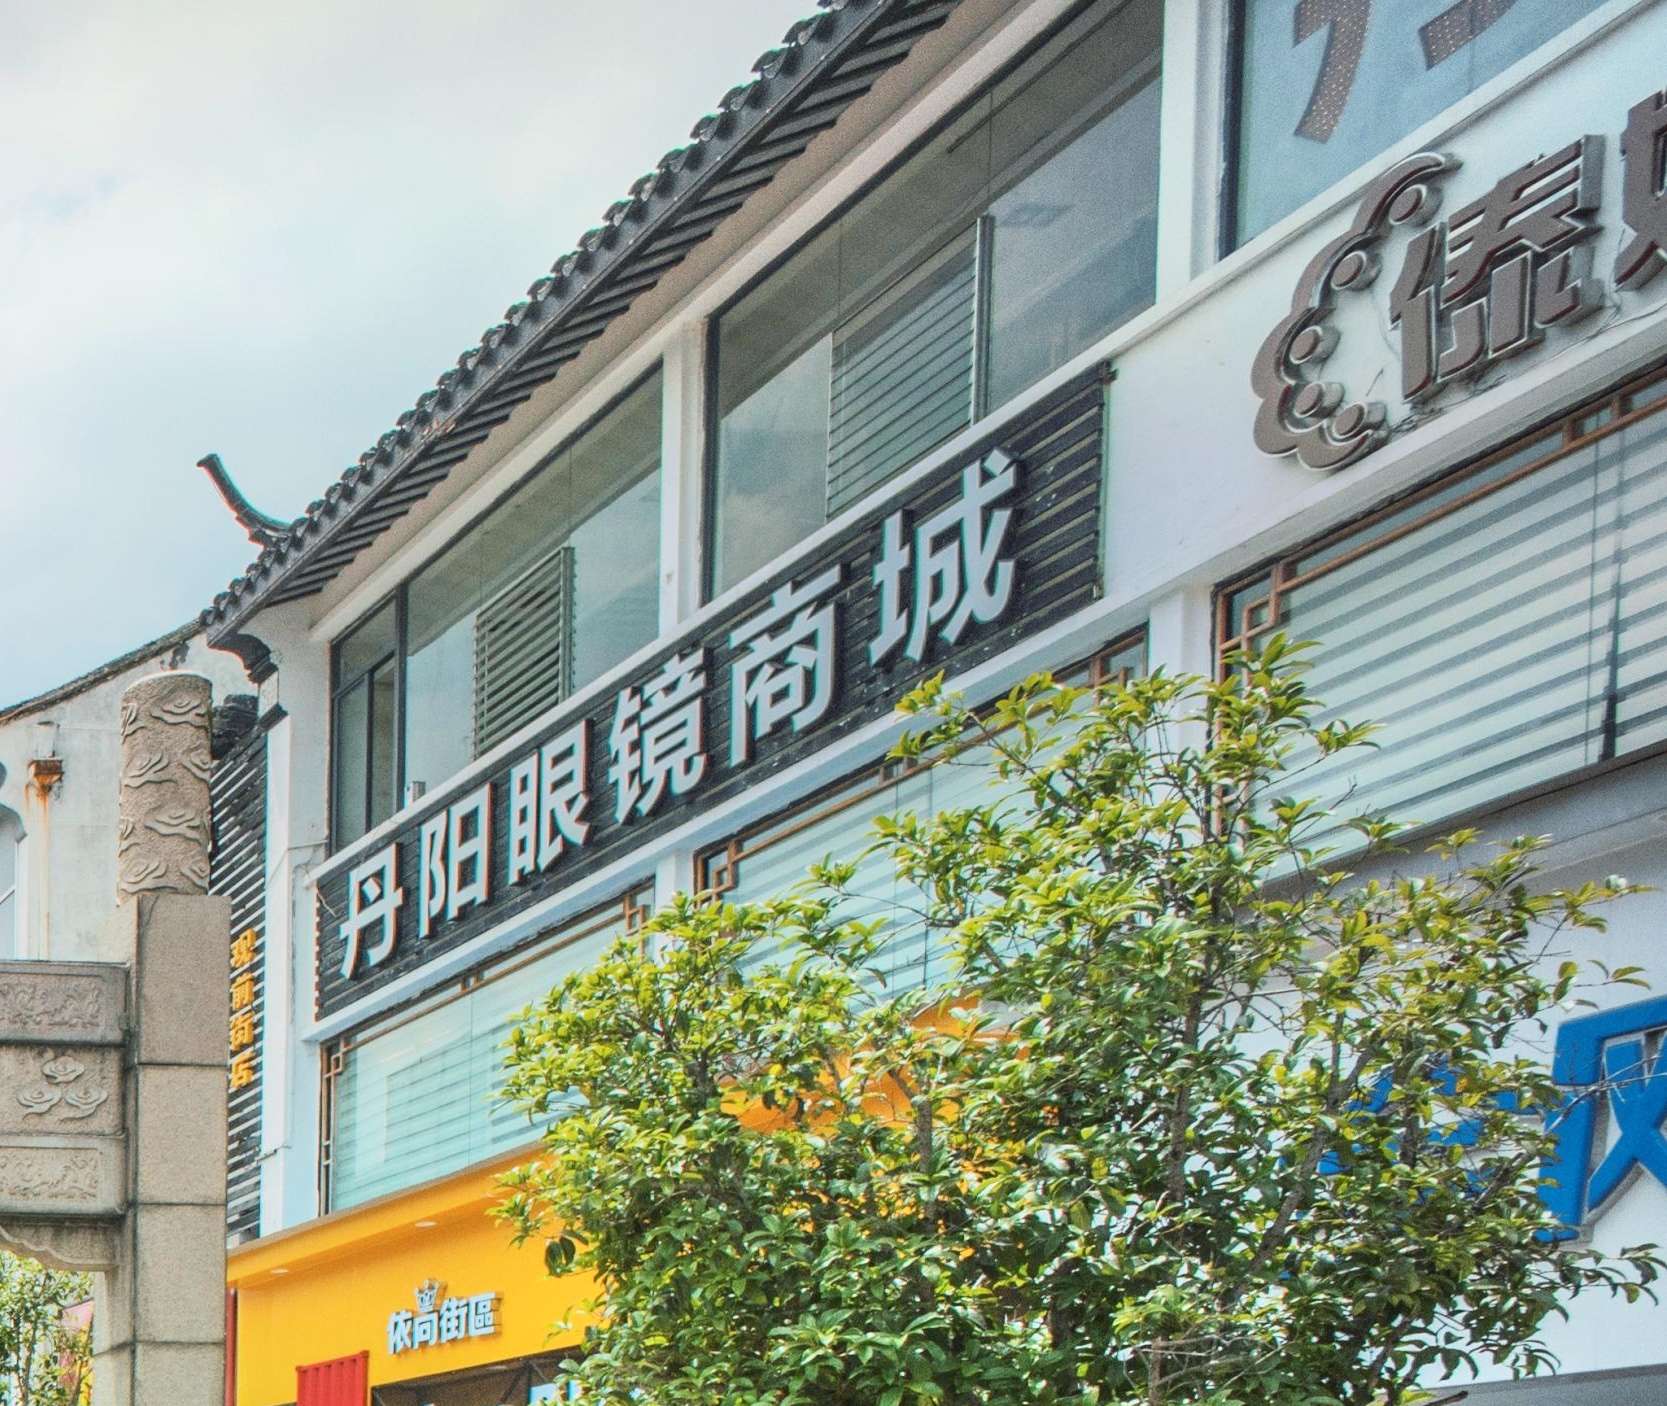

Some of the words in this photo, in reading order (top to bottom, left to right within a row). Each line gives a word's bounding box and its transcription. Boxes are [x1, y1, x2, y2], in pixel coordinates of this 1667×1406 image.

[338, 449, 1022, 981] 丹阳眼镜商城
[230, 928, 257, 1089] 观前街店
